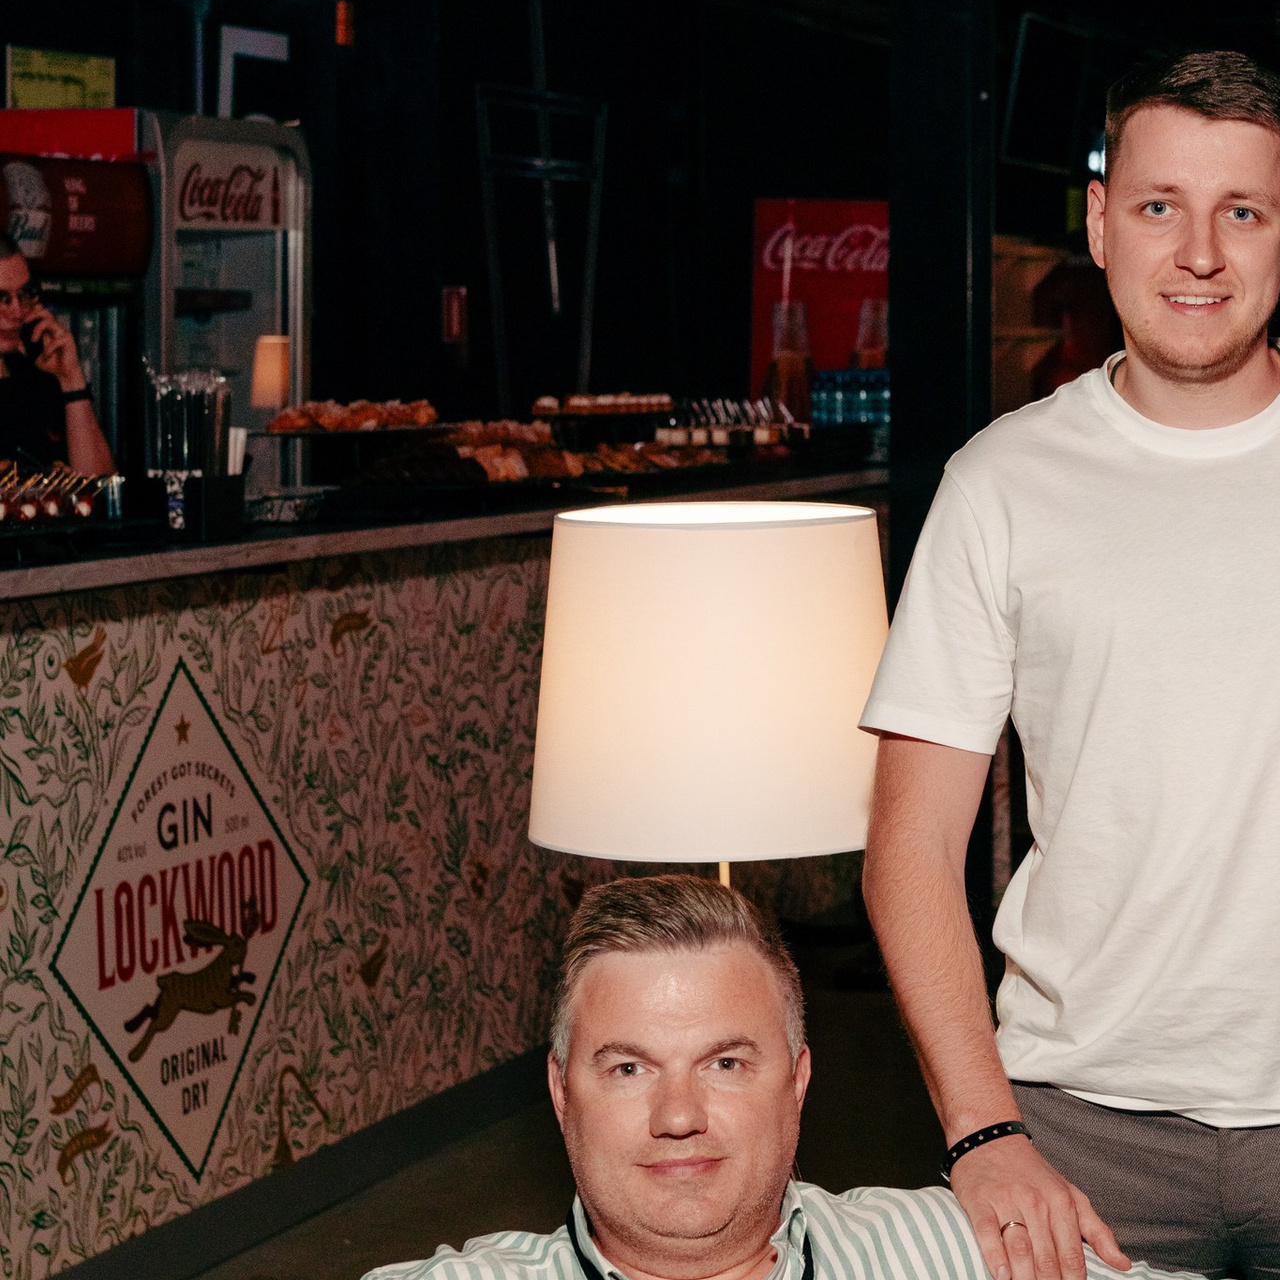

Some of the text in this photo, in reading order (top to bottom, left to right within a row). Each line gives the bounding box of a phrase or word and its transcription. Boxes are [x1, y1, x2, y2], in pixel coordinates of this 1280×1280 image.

[131, 761, 236, 823] FOREST GOT SECRETS
[157, 792, 213, 851] GIN
[95, 838, 277, 990] LOCKWOOD
[161, 1035, 227, 1086] ORIGINAL
[182, 1078, 209, 1114] DRY
